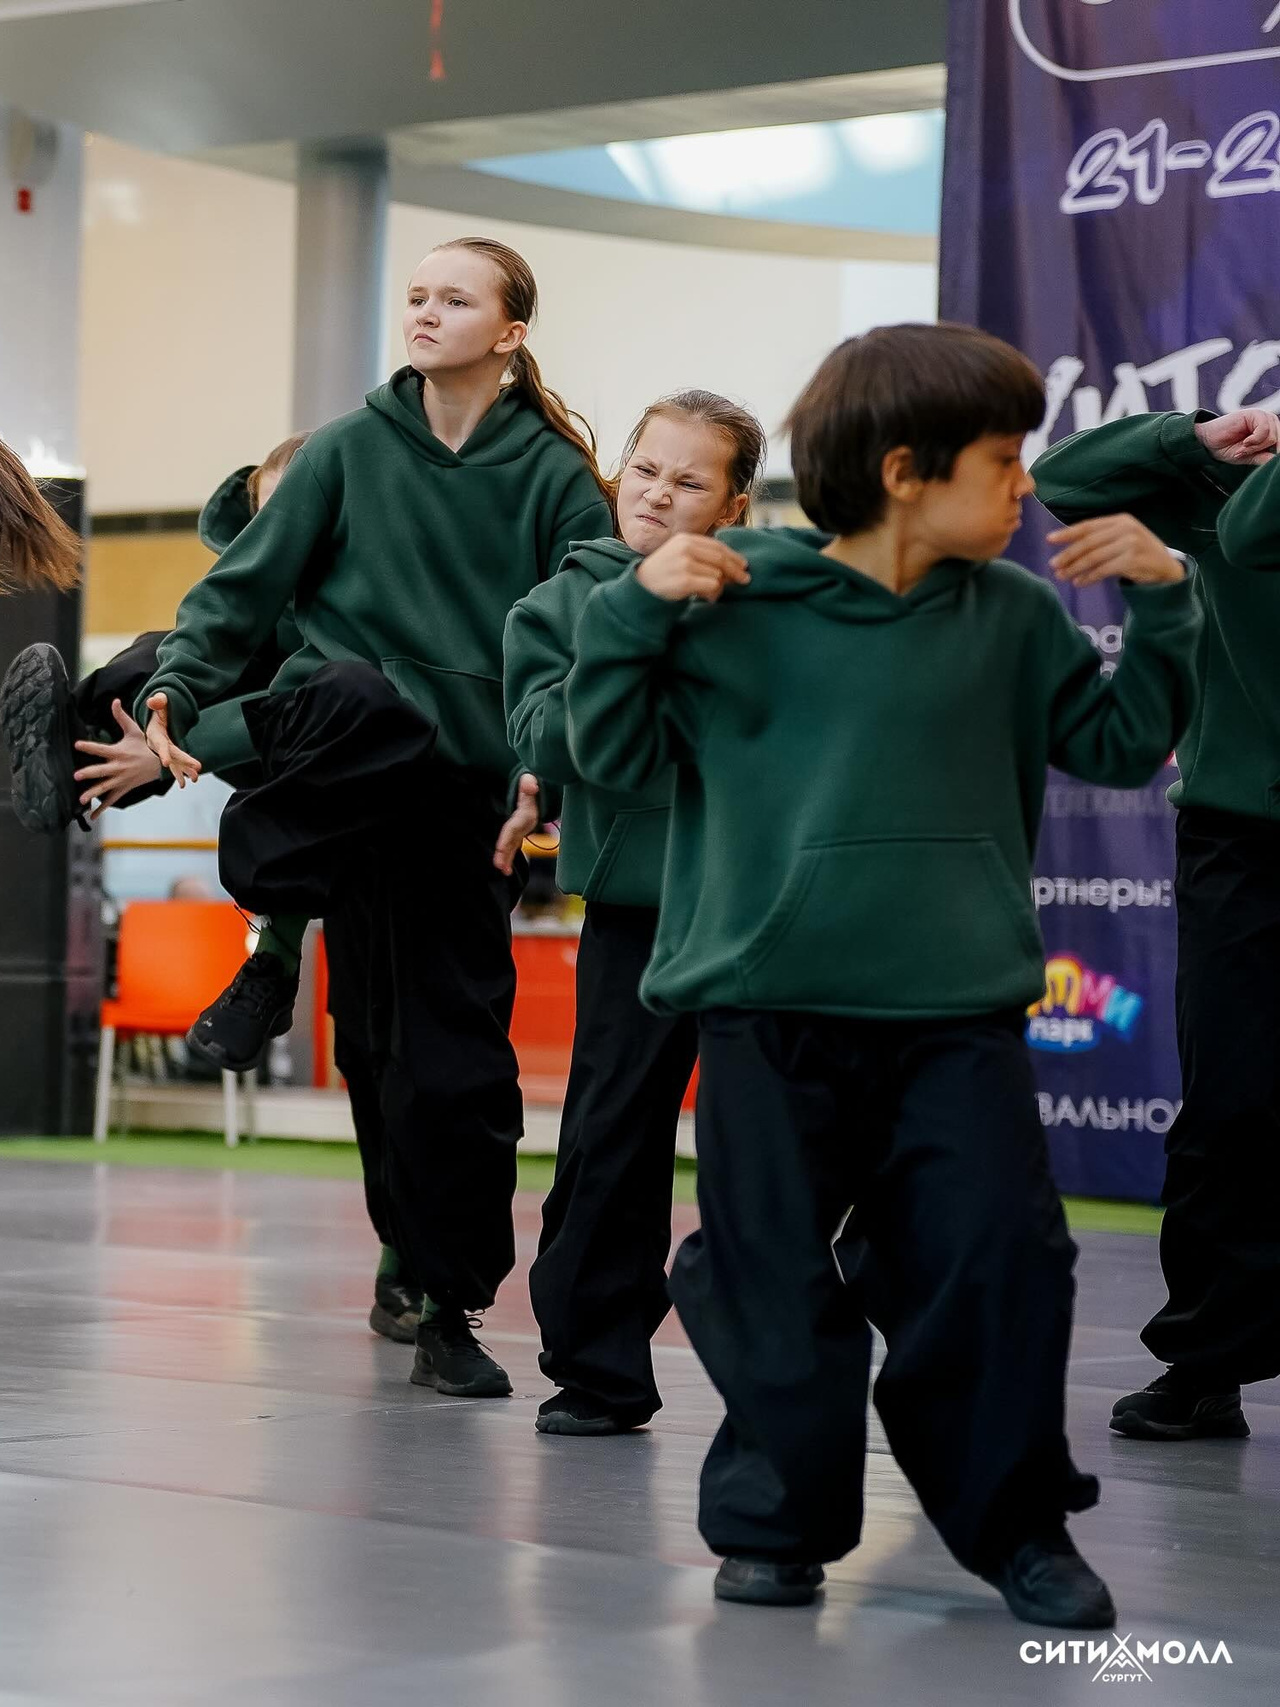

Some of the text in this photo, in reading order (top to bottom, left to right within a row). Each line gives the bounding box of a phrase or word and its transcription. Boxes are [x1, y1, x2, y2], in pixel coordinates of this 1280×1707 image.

[1059, 110, 1280, 214] 21-2
[1031, 876, 1172, 913] ртнеры:
[1035, 1091, 1184, 1134] ВАЛЬНО
